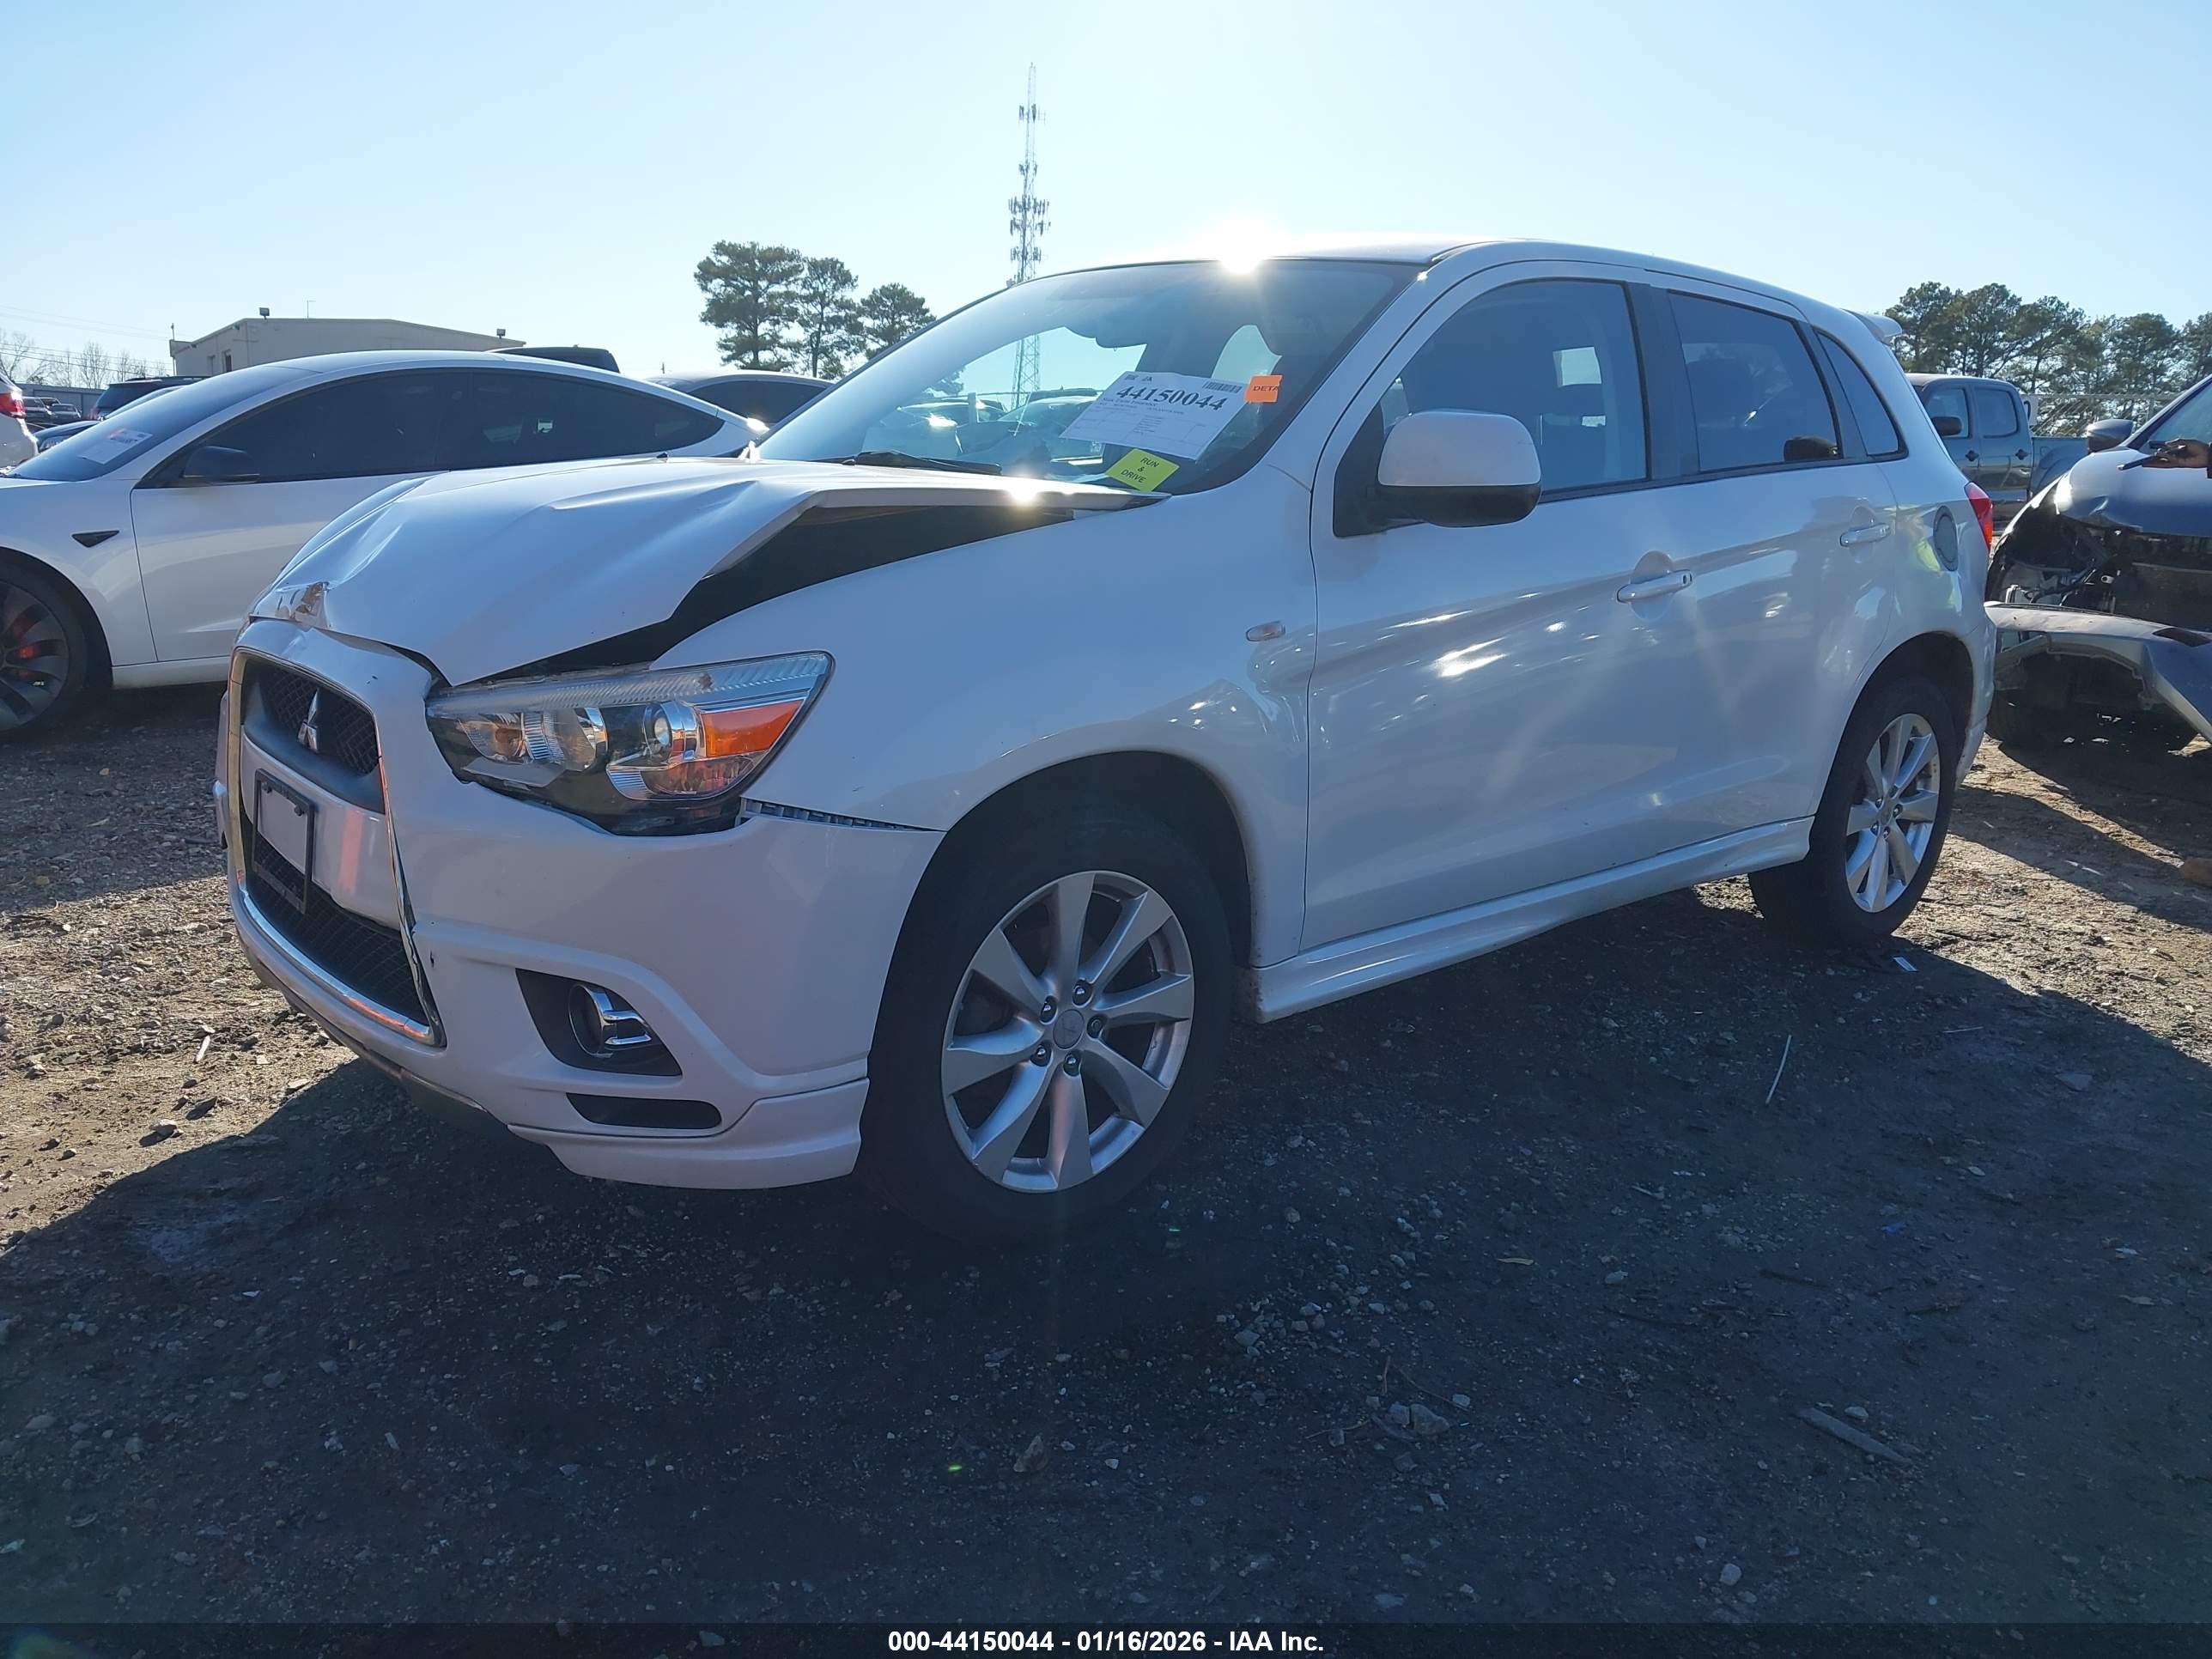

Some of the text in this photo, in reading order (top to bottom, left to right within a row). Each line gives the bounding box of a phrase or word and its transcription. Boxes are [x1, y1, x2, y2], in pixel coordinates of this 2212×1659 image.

[1116, 386, 1227, 410] 44150044
[1140, 457, 1159, 467] RUN
[1121, 469, 1146, 483] DRIVE
